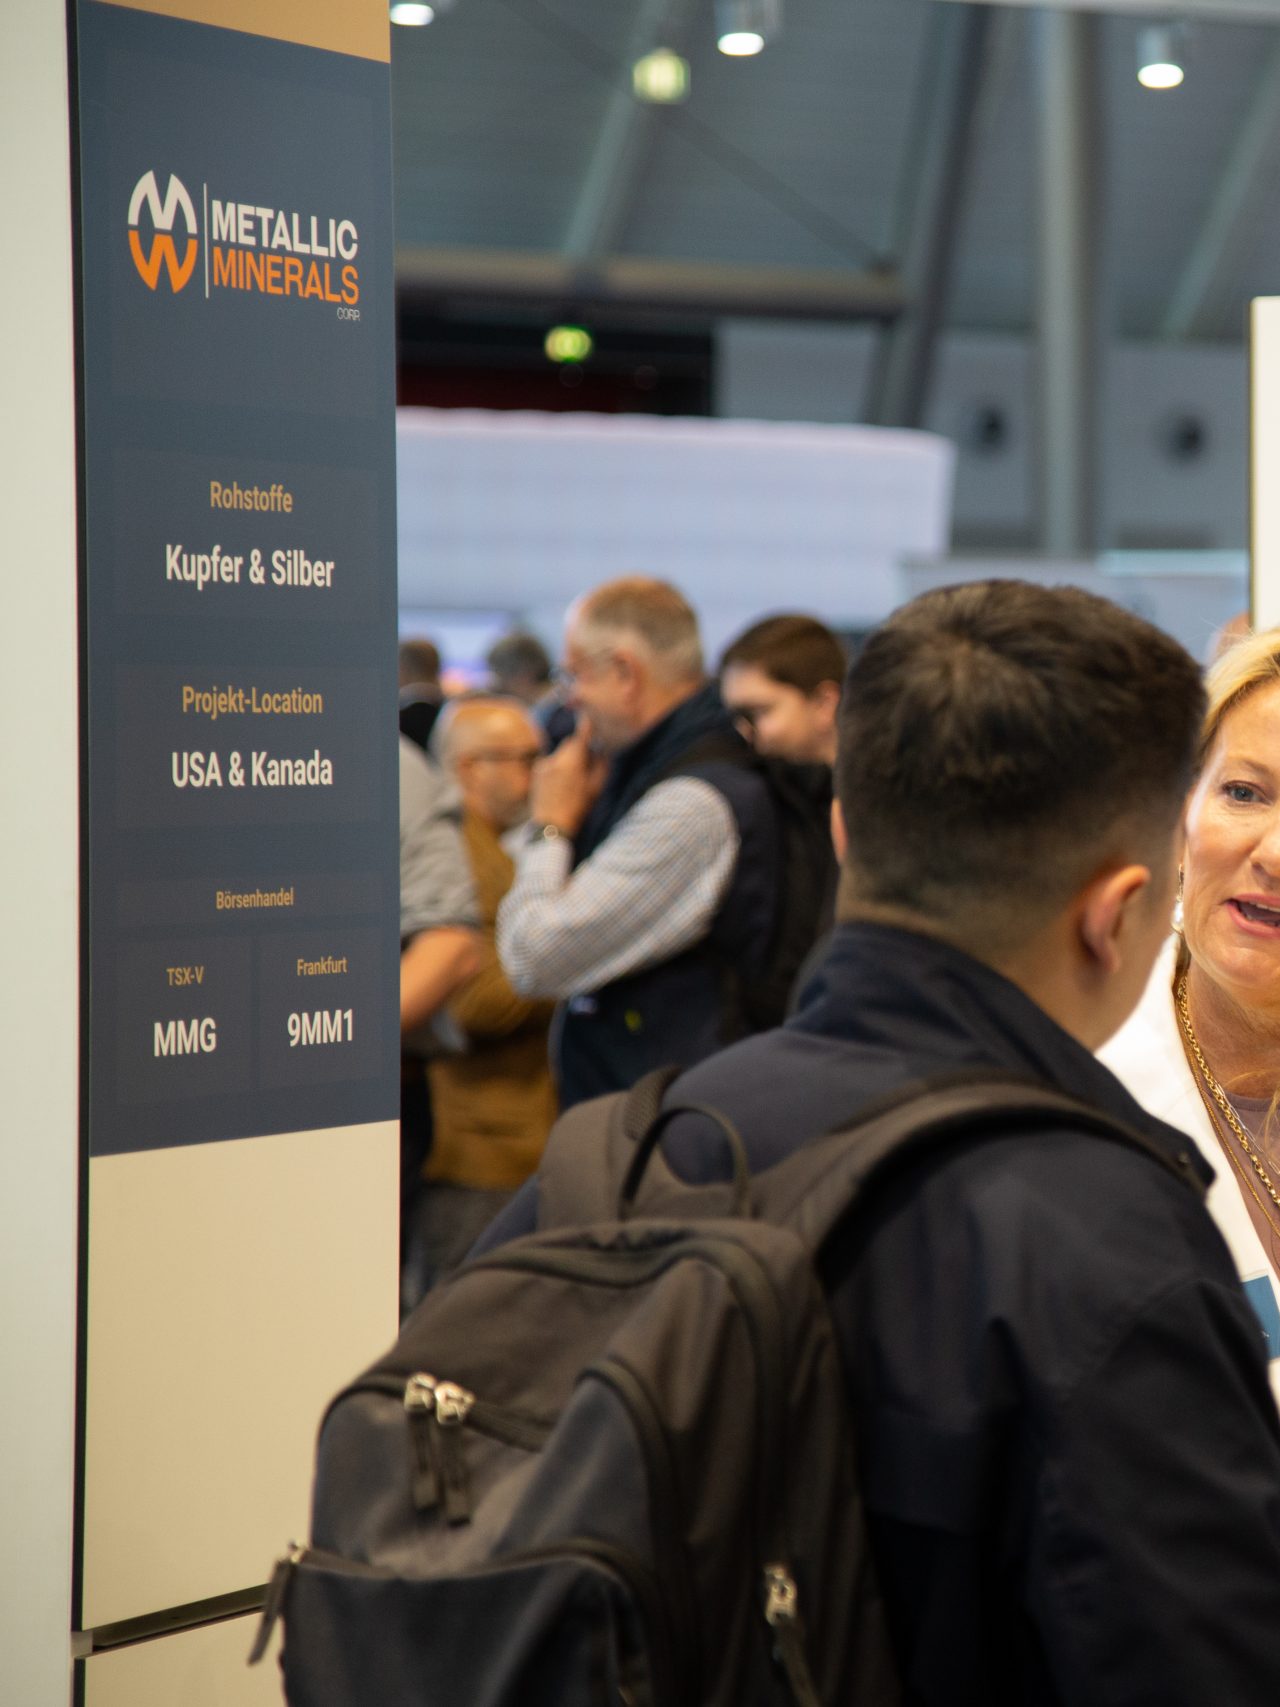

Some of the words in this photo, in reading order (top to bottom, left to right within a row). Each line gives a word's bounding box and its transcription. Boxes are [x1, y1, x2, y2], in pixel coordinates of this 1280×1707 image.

[211, 199, 359, 261] METALLIC
[212, 247, 360, 305] MINERALS
[210, 480, 294, 513] Rohstoffe
[166, 543, 243, 592] Kupfer
[249, 553, 265, 585] &
[271, 548, 335, 588] Silber
[182, 685, 323, 720] Projekt-Location
[172, 751, 222, 788] USA
[228, 751, 245, 787] &
[251, 749, 333, 787] Kanada
[216, 887, 294, 910] Börsenhandel
[166, 966, 205, 986] TSX-V
[297, 957, 348, 977] Frankfurt
[153, 1017, 217, 1057] MMG
[287, 1008, 354, 1048] 9MM1
